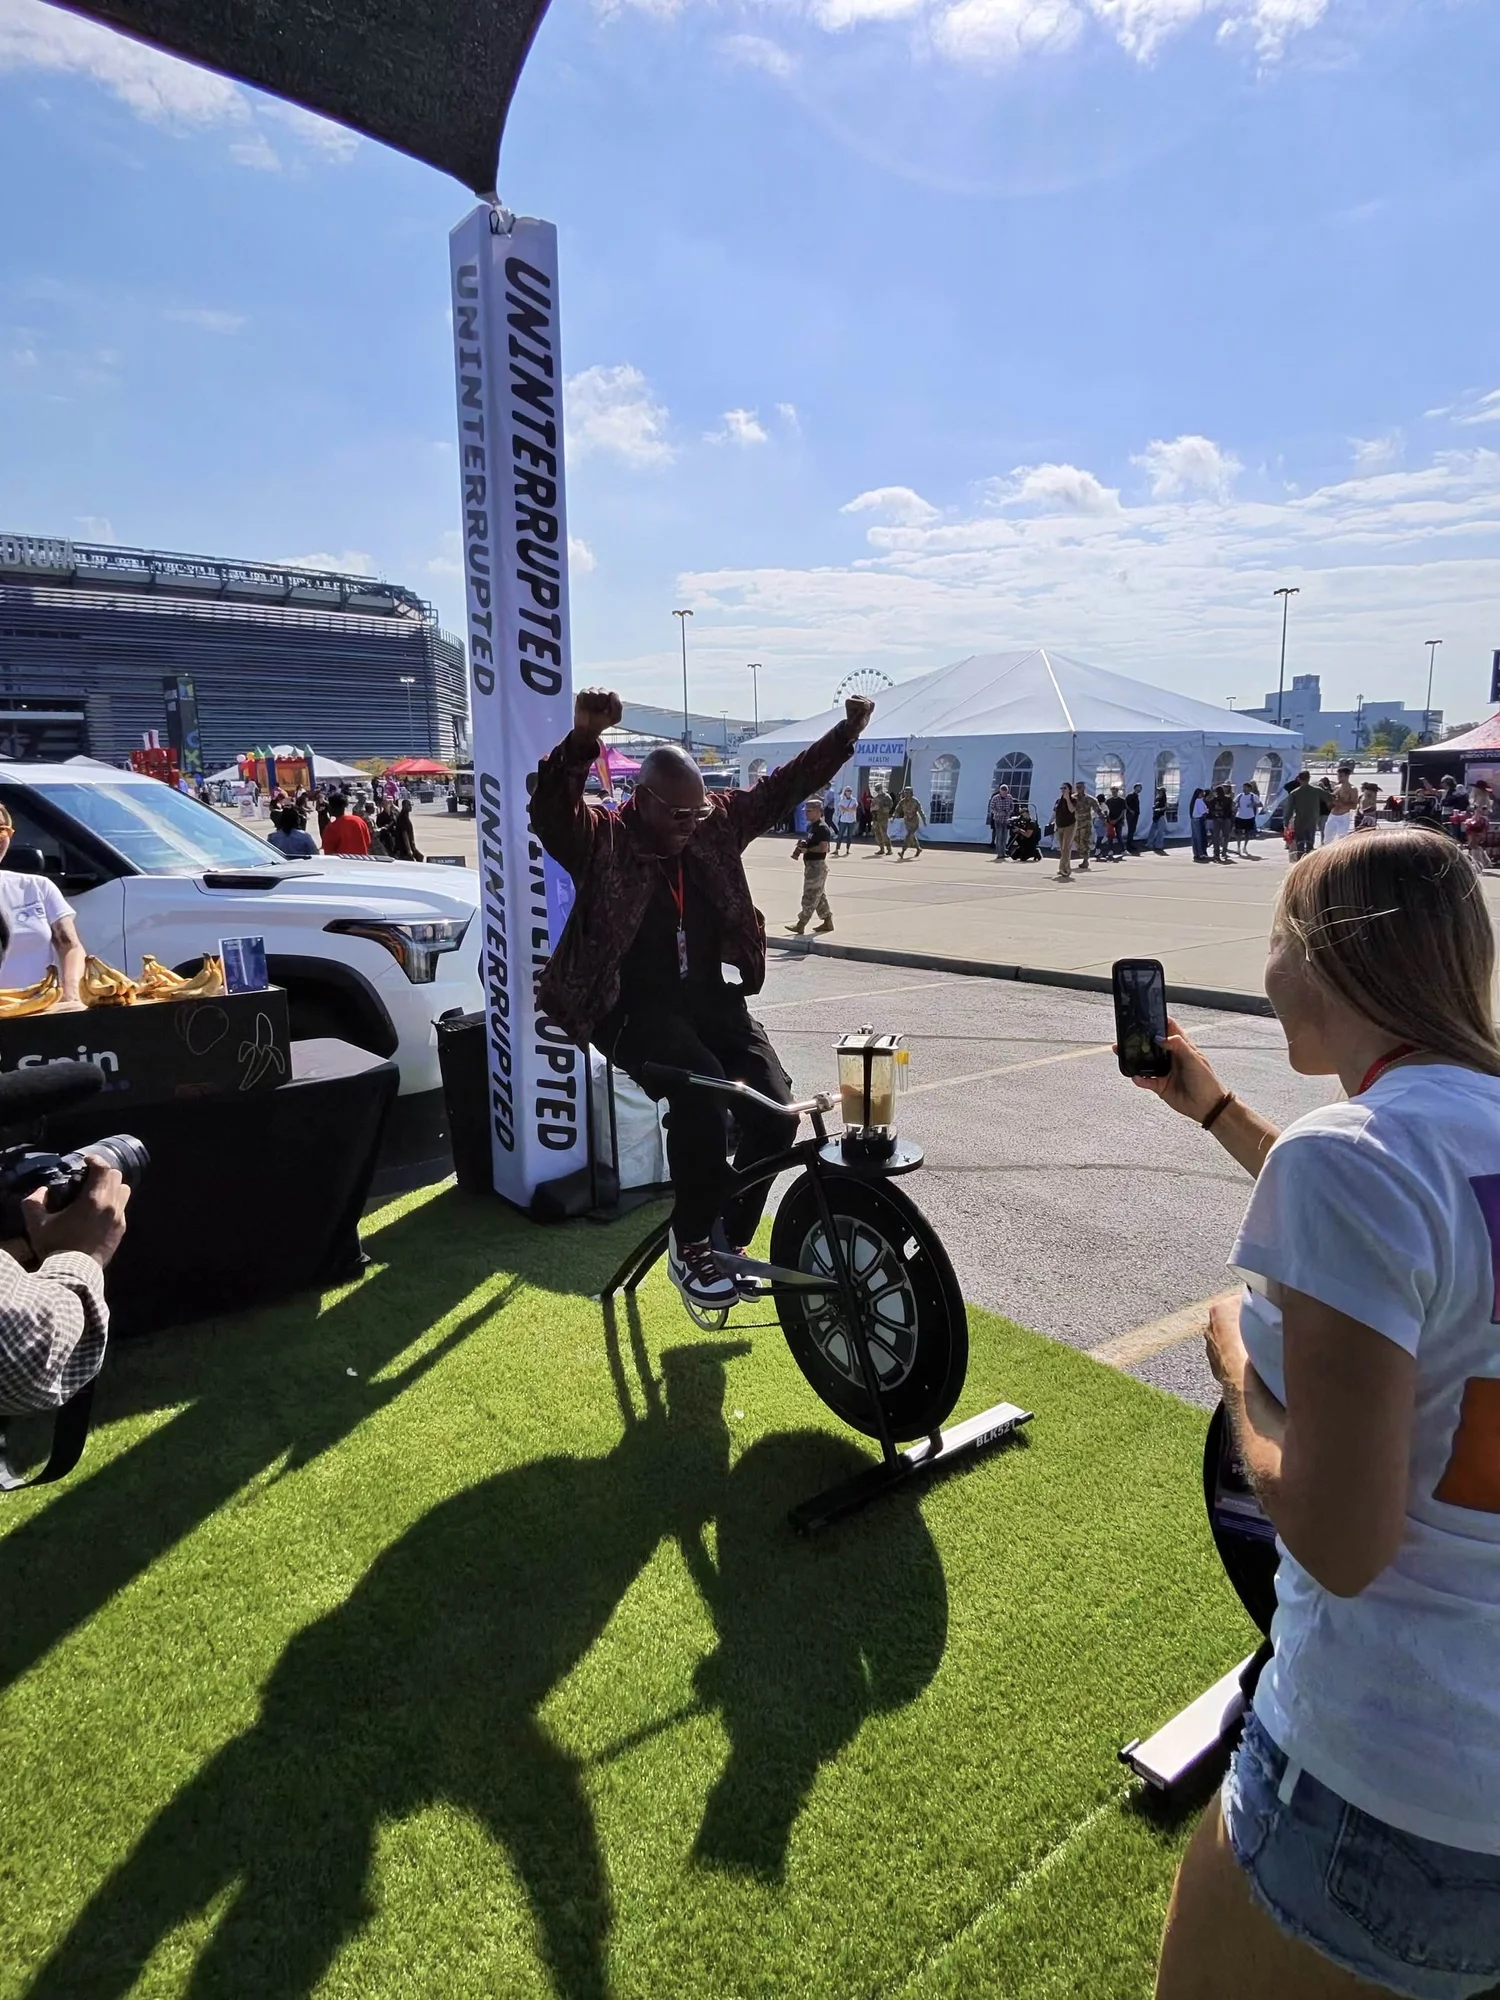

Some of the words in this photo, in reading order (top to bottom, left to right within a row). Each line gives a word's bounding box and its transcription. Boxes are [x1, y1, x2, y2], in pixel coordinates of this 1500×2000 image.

[456, 264, 495, 696] UNINTERRUPTED
[504, 256, 562, 697] UNINTERRUPTED
[857, 743, 878, 754] MAN
[879, 743, 904, 754] CAVE
[18, 1045, 119, 1072] sin
[479, 772, 516, 1153] UNINTERRUPTED
